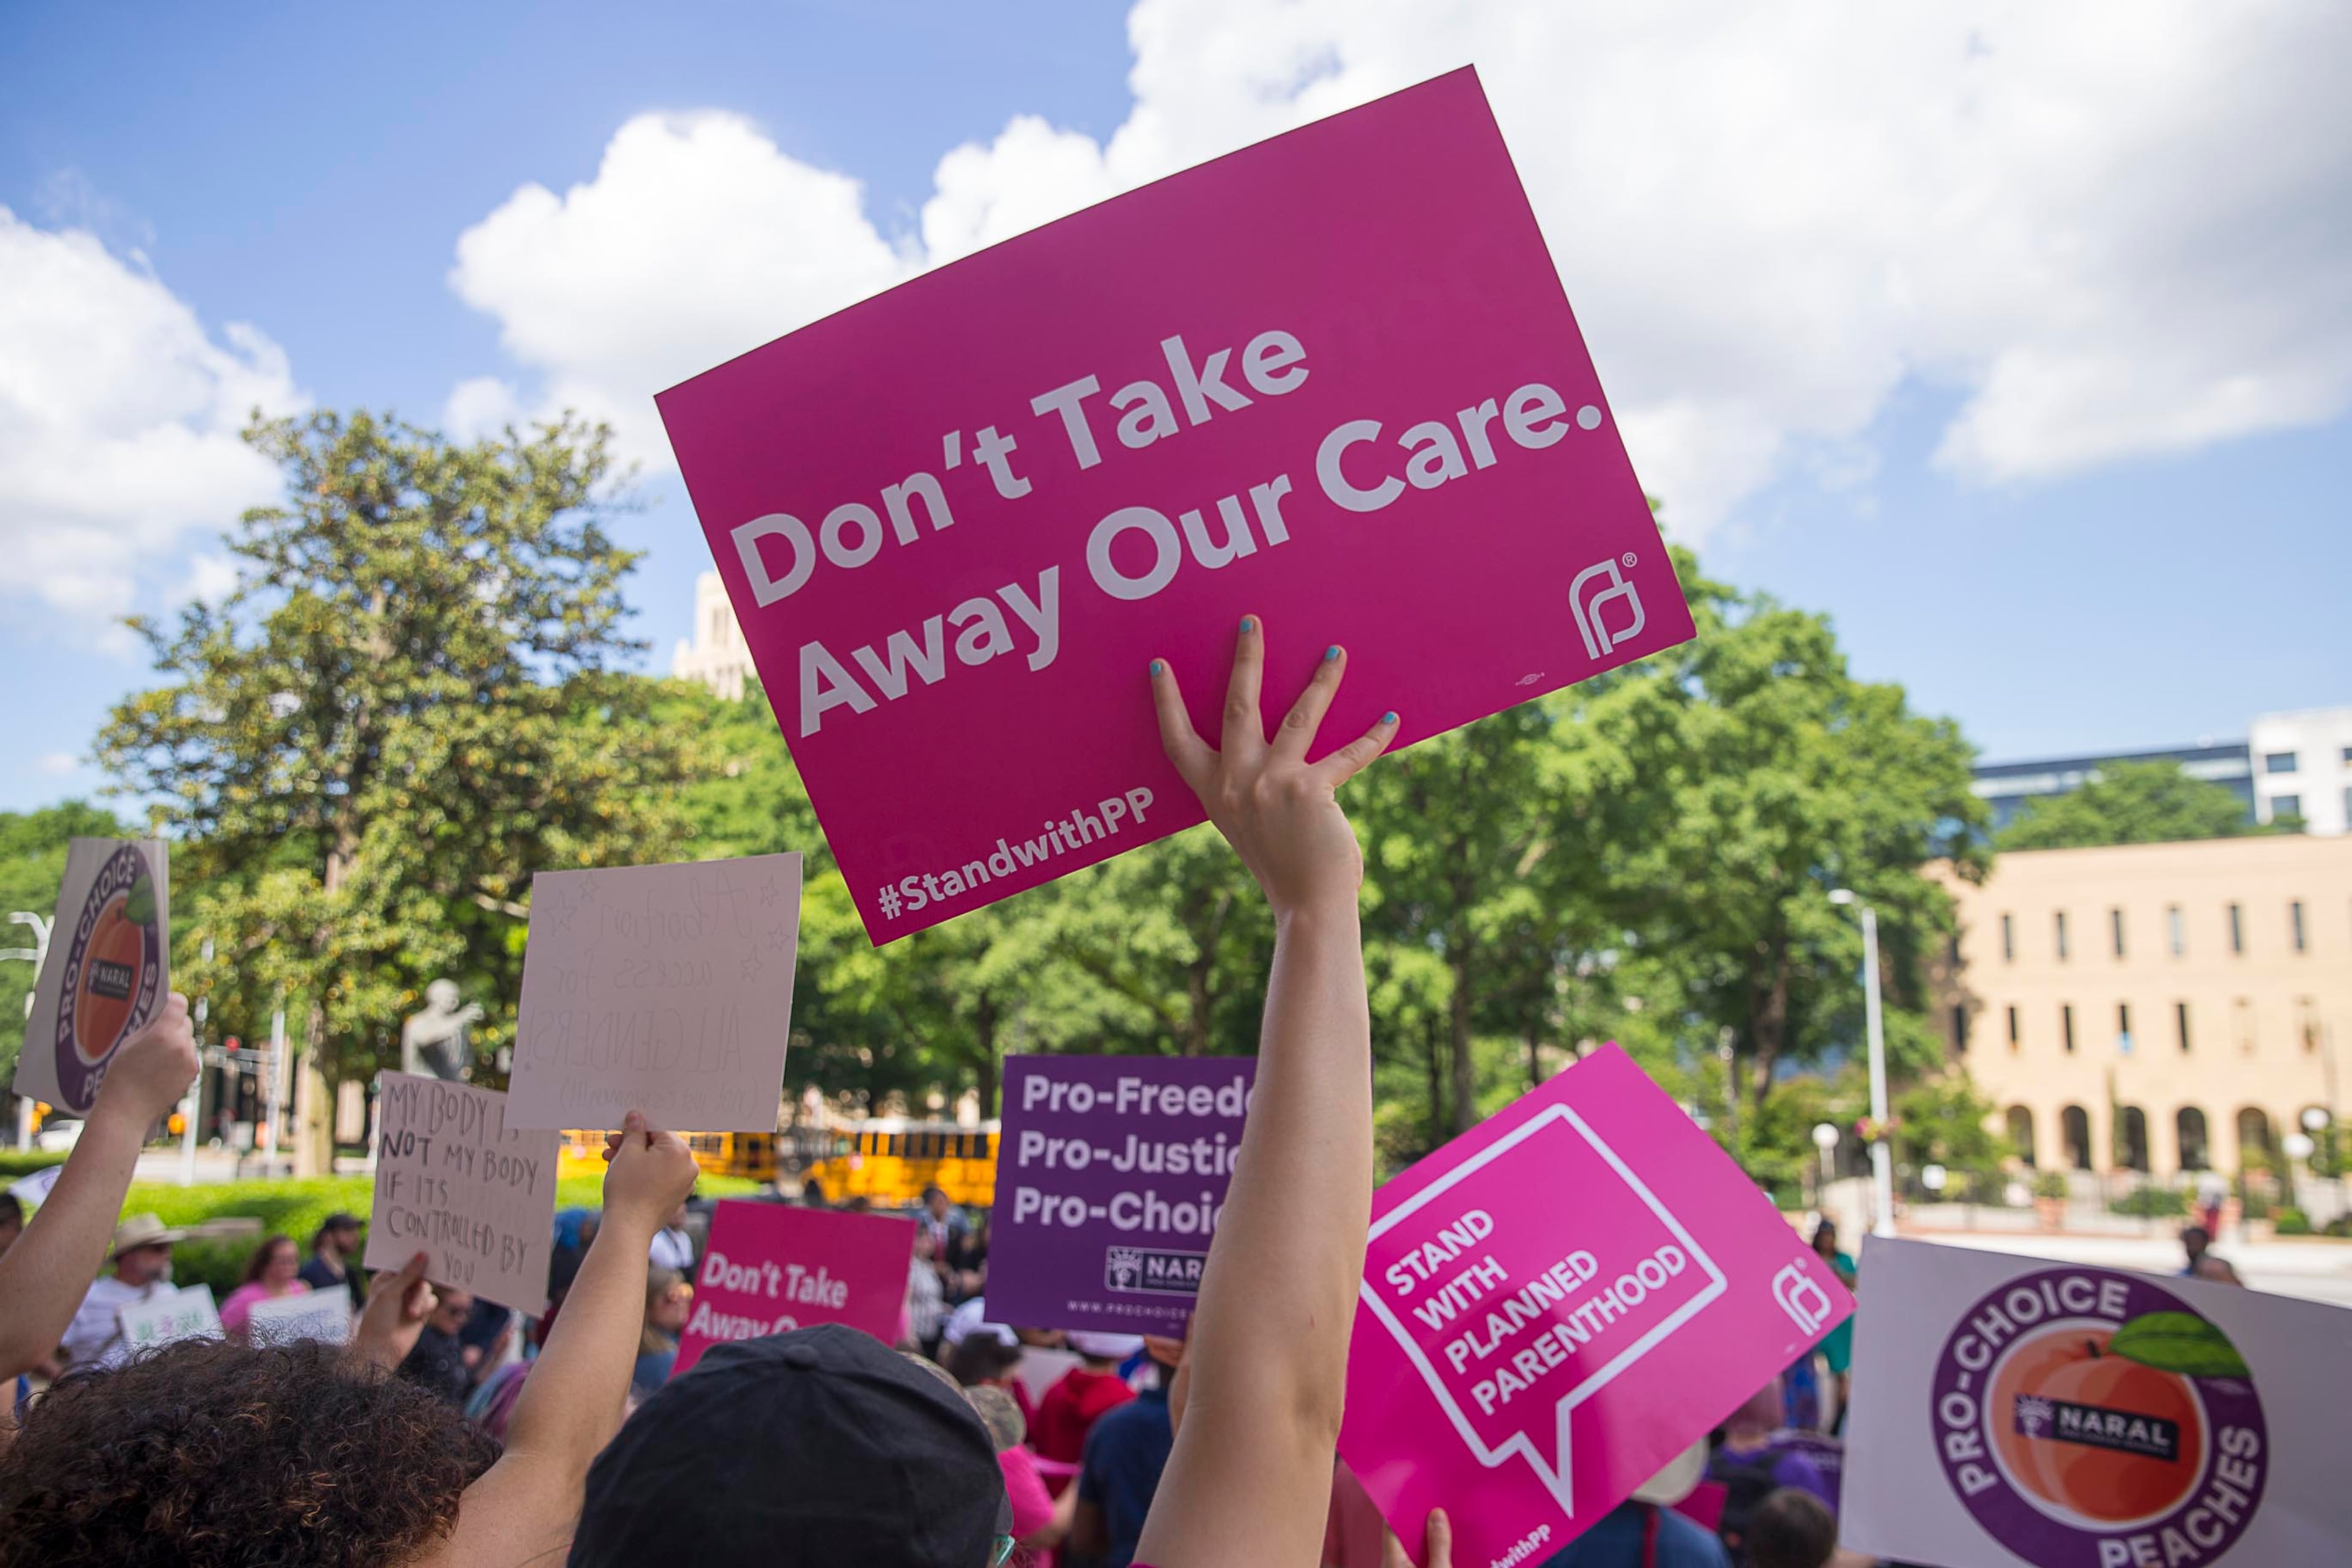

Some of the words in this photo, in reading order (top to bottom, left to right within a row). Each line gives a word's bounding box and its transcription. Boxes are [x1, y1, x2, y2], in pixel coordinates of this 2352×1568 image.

[729, 425, 1033, 608] Don't
[1030, 330, 1310, 470] Take
[799, 565, 1060, 738] Away
[1085, 473, 1293, 600] Our
[1315, 383, 1602, 512] Care.
[878, 786, 1154, 921] #StandwithPP
[58, 851, 136, 1043] PRO-CHOICE
[100, 966, 130, 989] NARAL
[386, 1082, 421, 1128] MY
[428, 1082, 489, 1147] BODY
[1022, 1074, 1254, 1117] Pro-Freed
[380, 1129, 432, 1167] NOT
[443, 1143, 476, 1183] MY
[483, 1148, 538, 1196] BODY
[383, 1170, 403, 1201] IF
[415, 1174, 448, 1209] ITS
[1013, 1186, 1224, 1235] Pro-Choi
[443, 1251, 475, 1285] YOU
[500, 1234, 529, 1275] BY
[701, 1251, 783, 1299] Don't
[785, 1263, 849, 1310] Take
[1147, 1256, 1203, 1281] NAR
[1385, 1209, 1494, 1297] STAND
[1412, 1254, 1510, 1332] WITH
[1444, 1250, 1599, 1376] PLANNED
[1470, 1244, 1687, 1417] PARENTHOOD
[1939, 1276, 2130, 1497] PRO-CHOICE
[2059, 1406, 2171, 1447] NARAL
[2097, 1425, 2261, 1568] PEACHES
